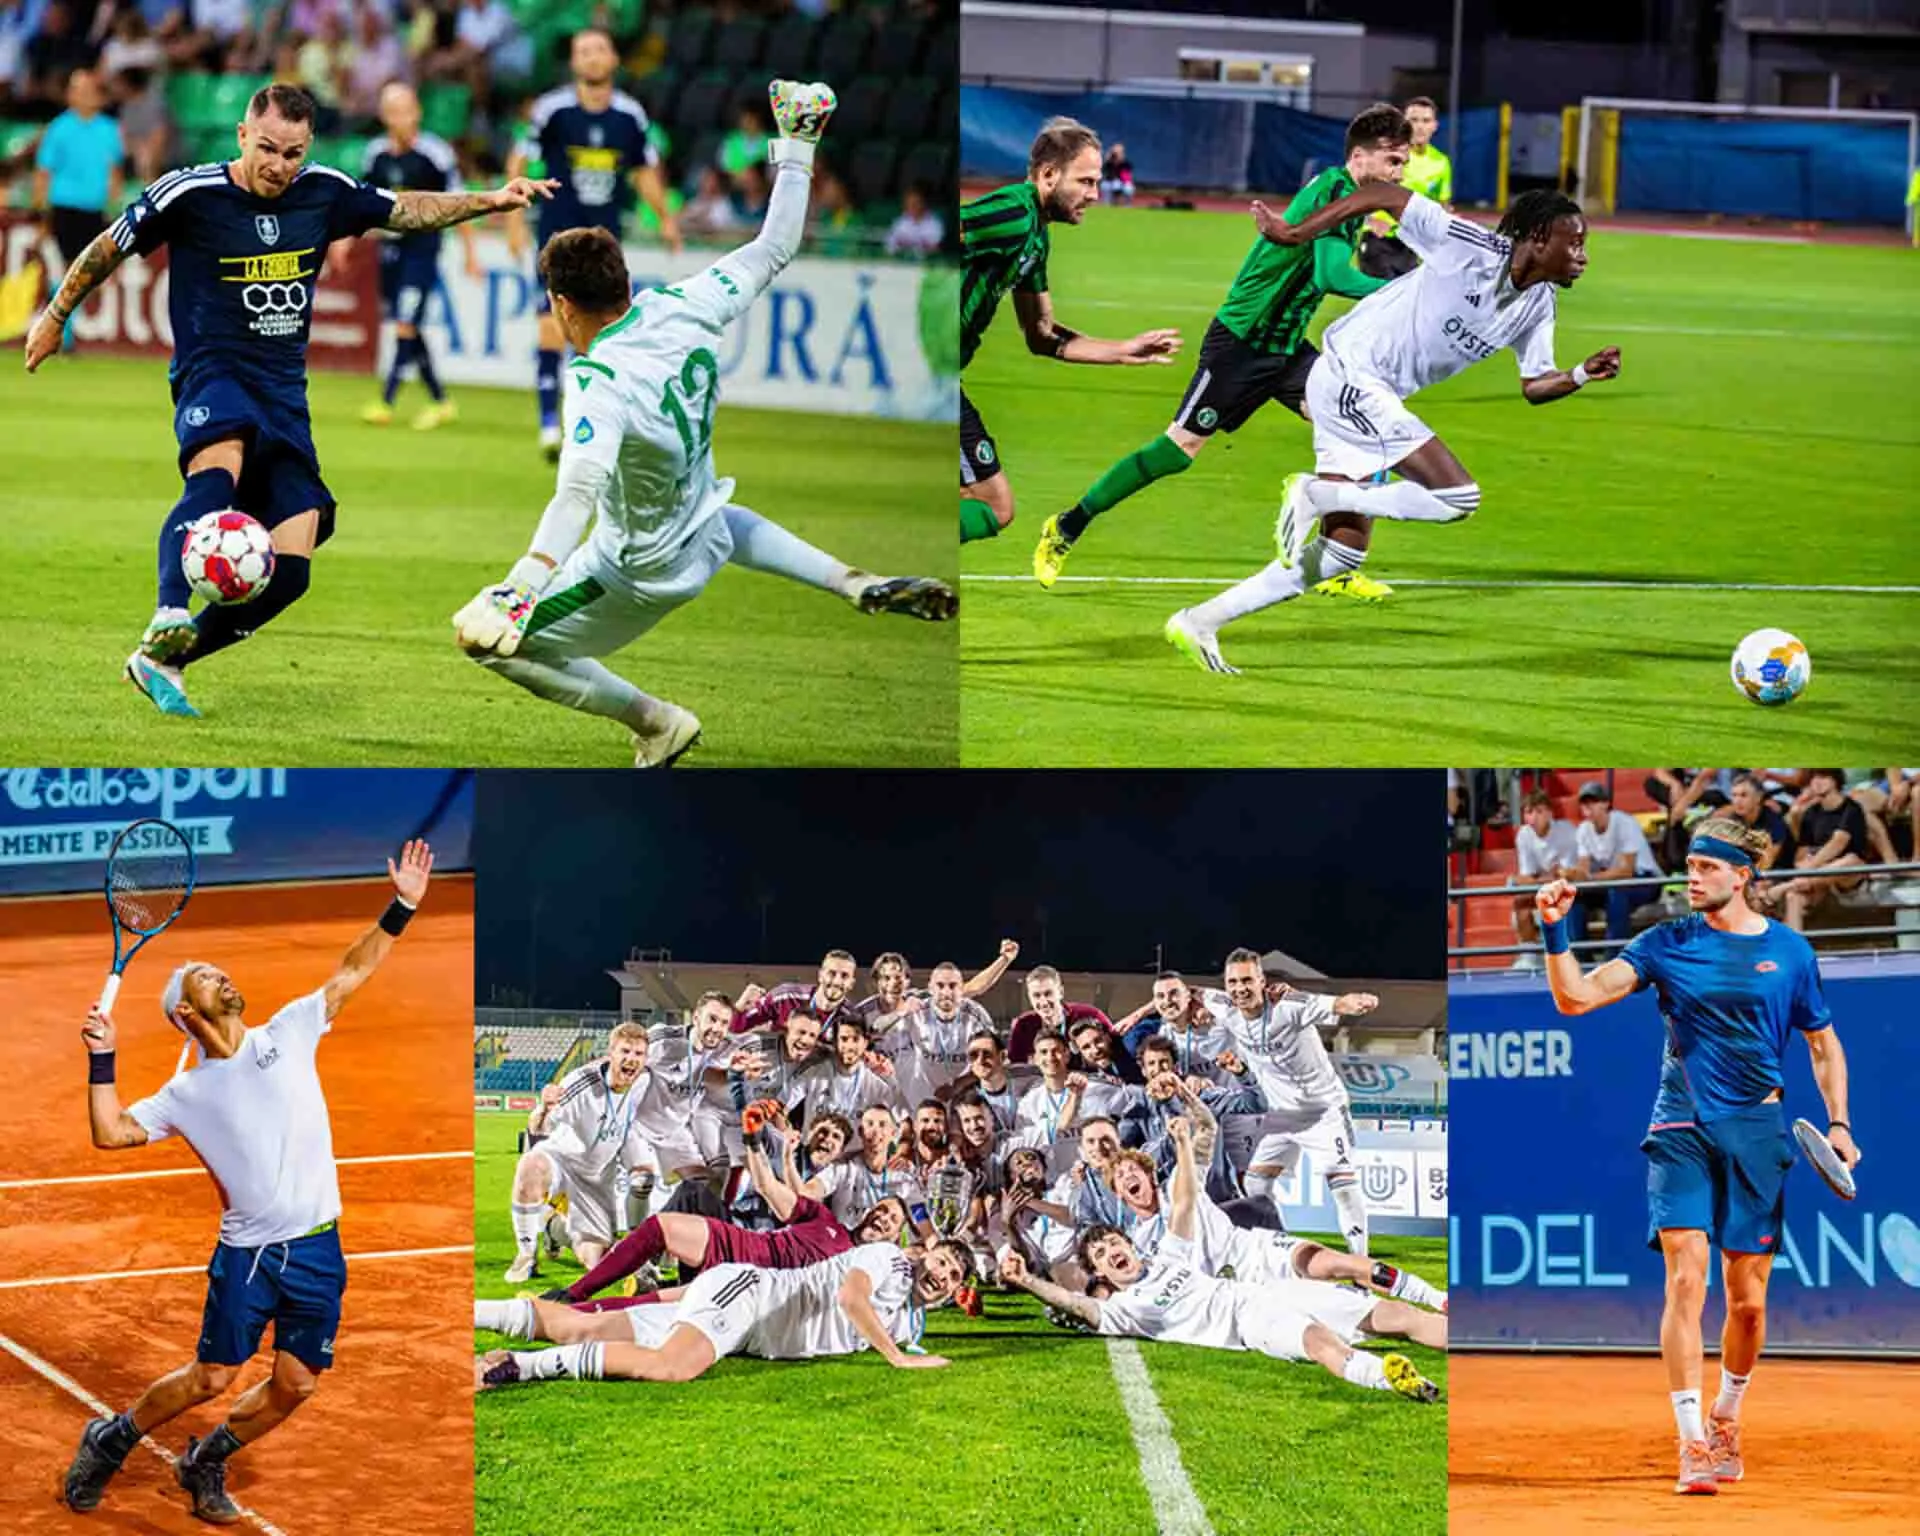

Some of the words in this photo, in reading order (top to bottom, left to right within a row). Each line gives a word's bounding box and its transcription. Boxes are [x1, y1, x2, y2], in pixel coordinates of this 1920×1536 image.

[45, 768, 126, 808] dello
[0, 832, 83, 856] MENTE
[1449, 1030, 1573, 1079] ENGER
[1481, 1213, 1629, 1286] DEL
